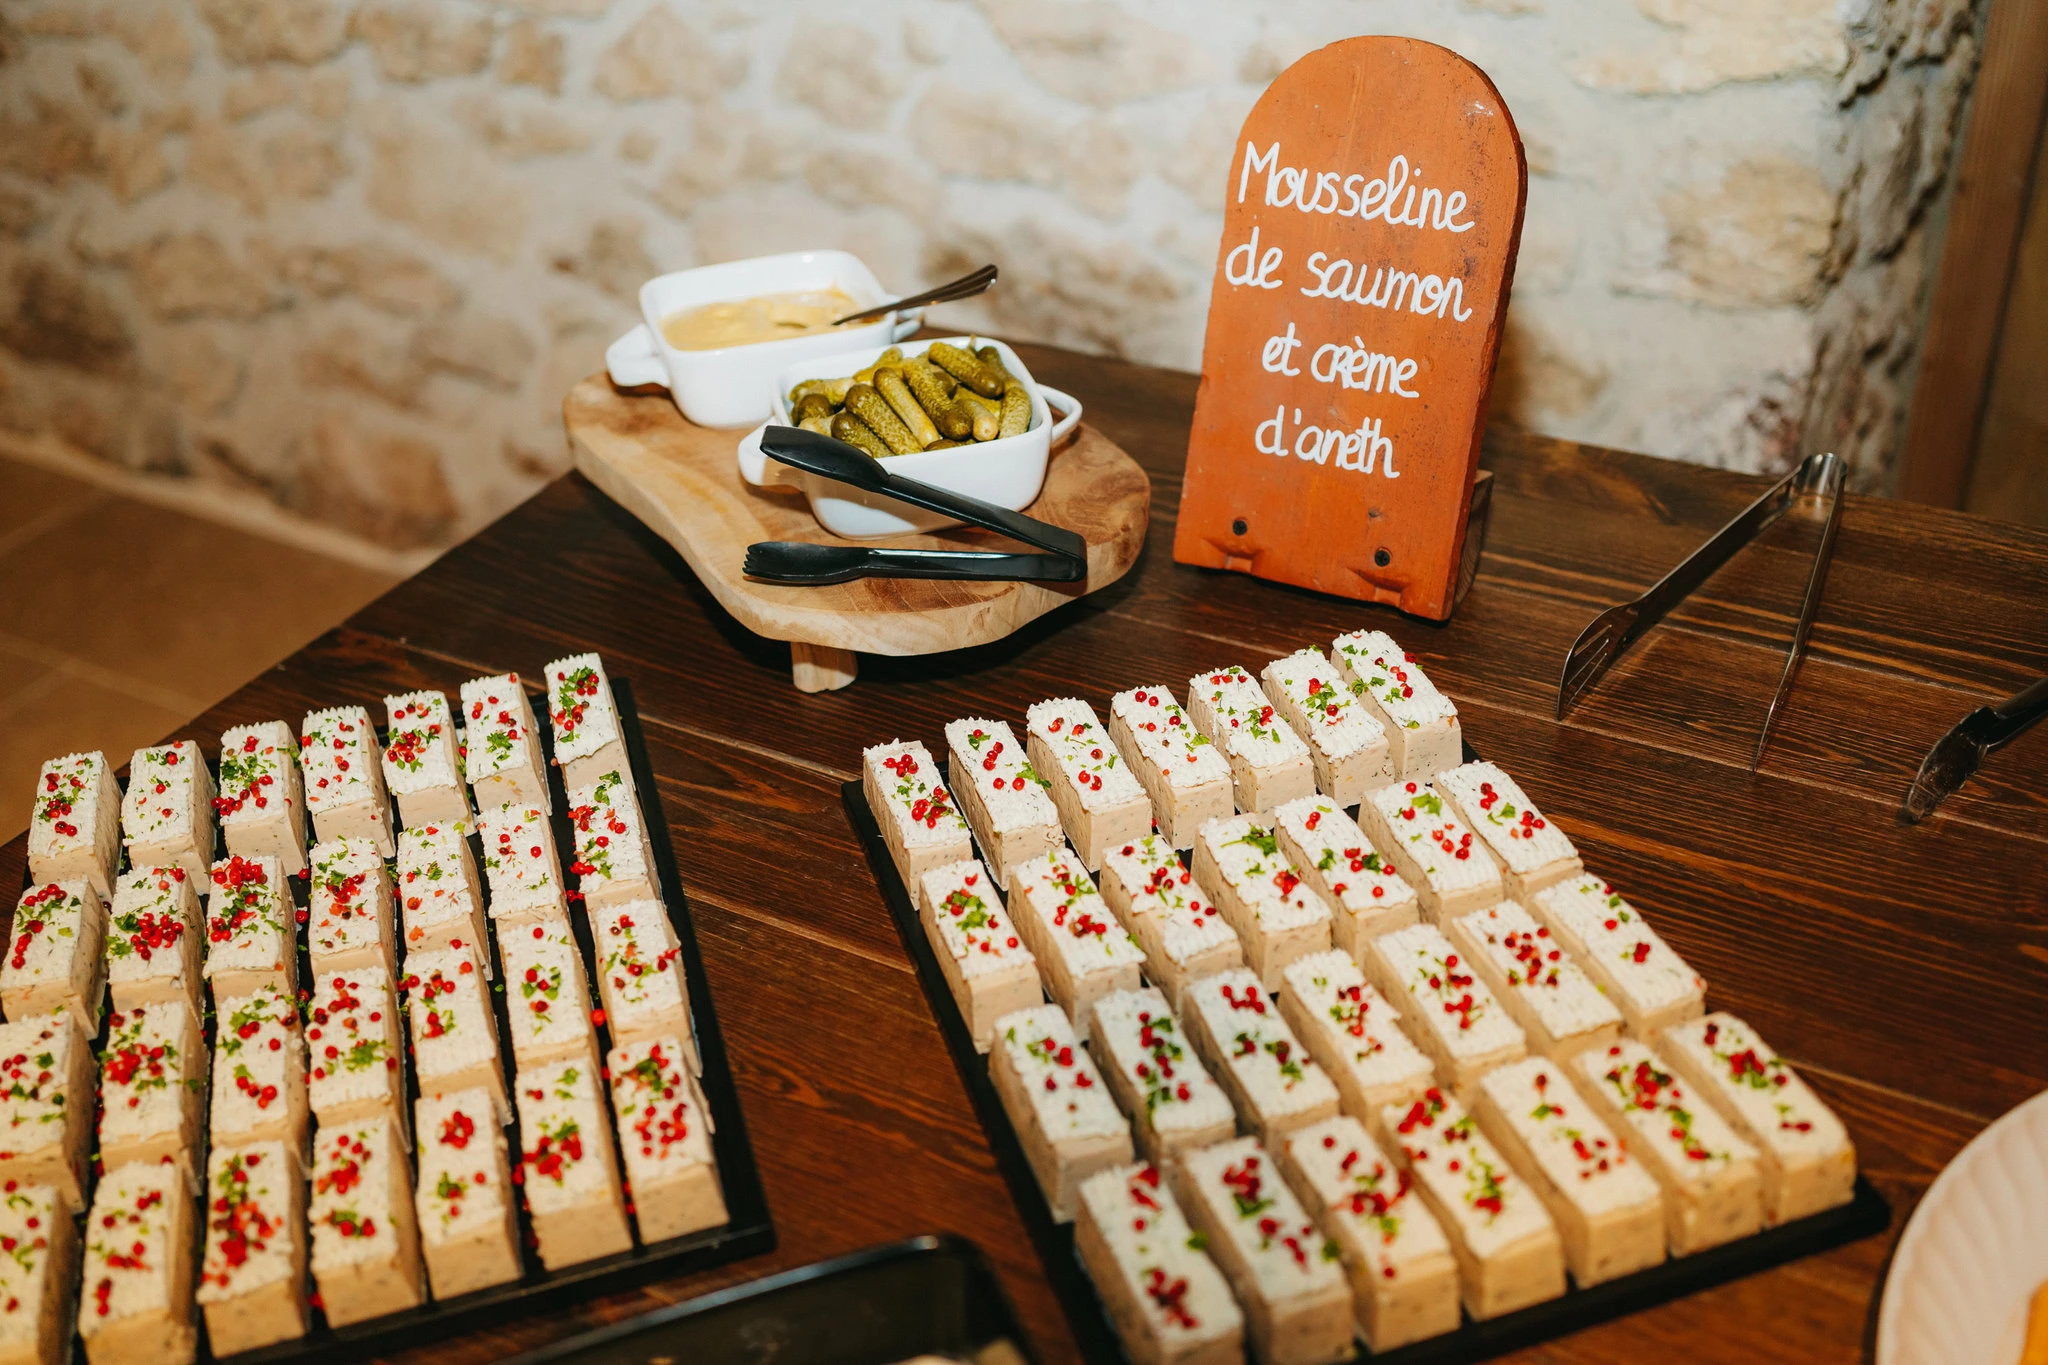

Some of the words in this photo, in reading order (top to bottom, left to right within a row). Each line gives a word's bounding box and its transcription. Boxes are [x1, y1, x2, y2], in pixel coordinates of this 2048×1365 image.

[1237, 140, 1476, 233] Mousseline
[1224, 226, 1284, 290] de
[1300, 251, 1473, 323] saumon
[1261, 321, 1303, 377] et
[1310, 335, 1420, 398] crème
[1254, 404, 1401, 479] d'aneth
